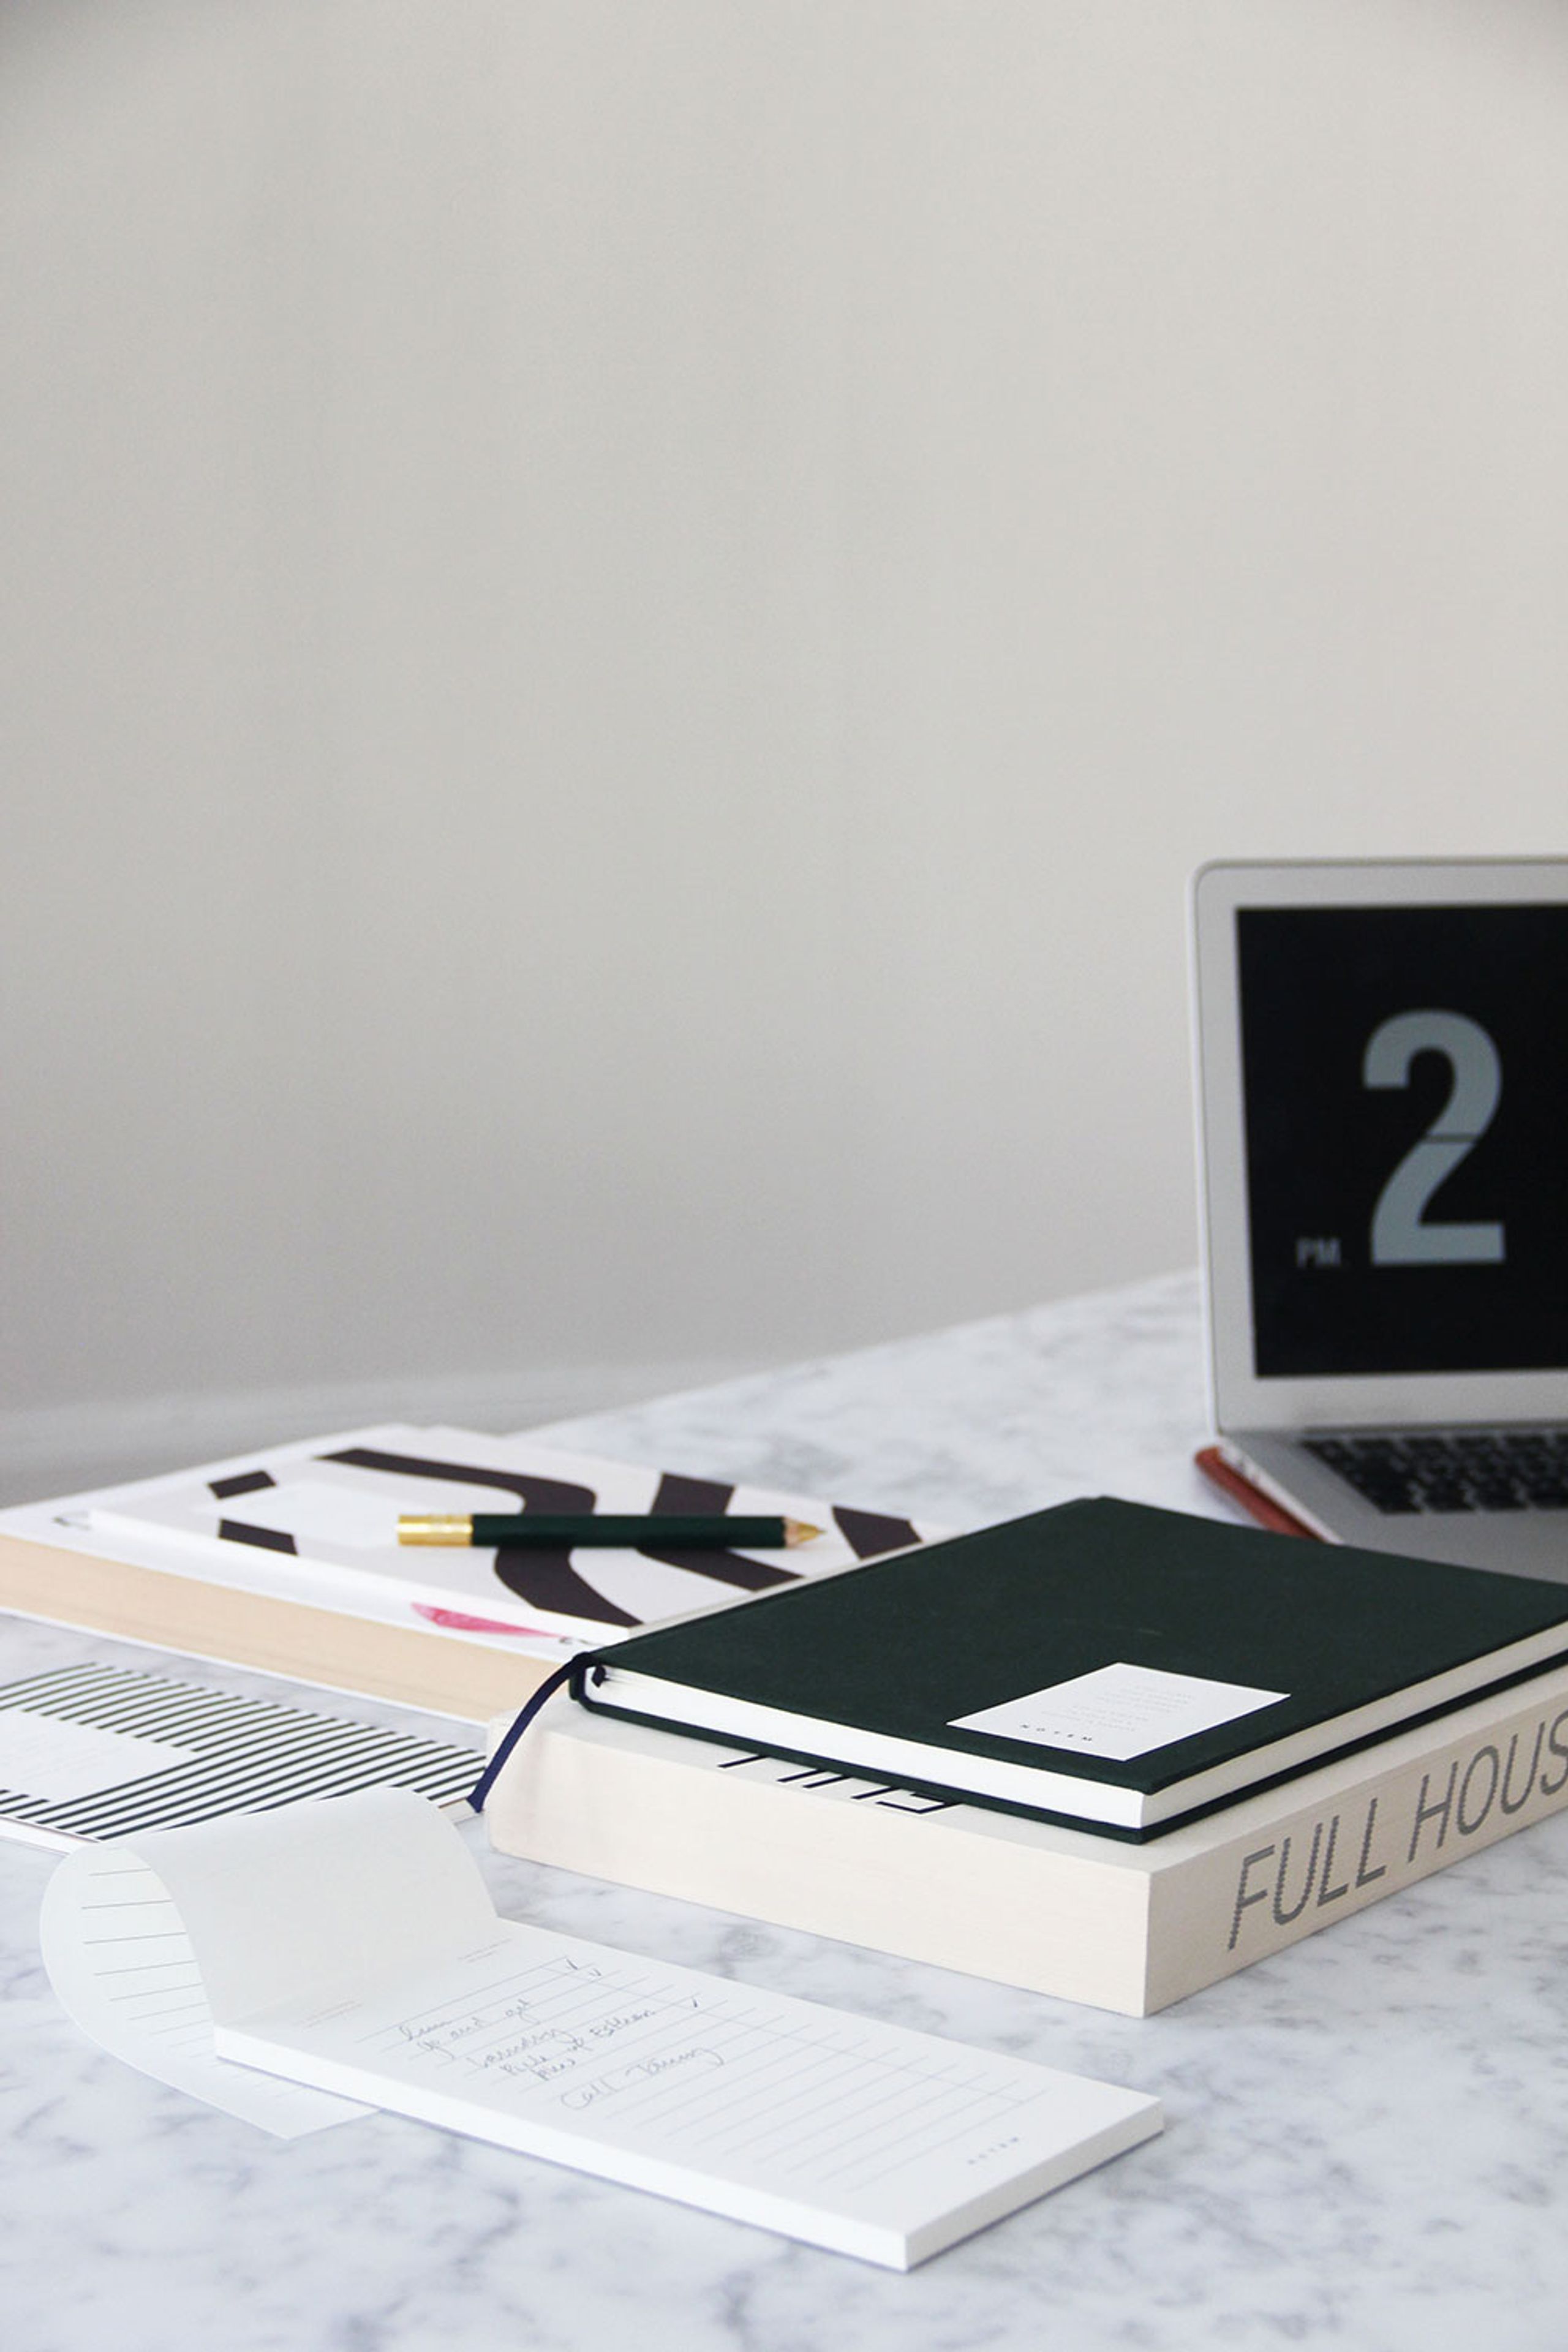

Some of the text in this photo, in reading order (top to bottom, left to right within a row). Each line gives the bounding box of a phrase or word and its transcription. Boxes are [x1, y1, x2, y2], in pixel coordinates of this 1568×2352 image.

[1363, 1008, 1506, 1266] 2
[1296, 1237, 1342, 1267] PM
[1229, 1797, 1387, 1950] FULL
